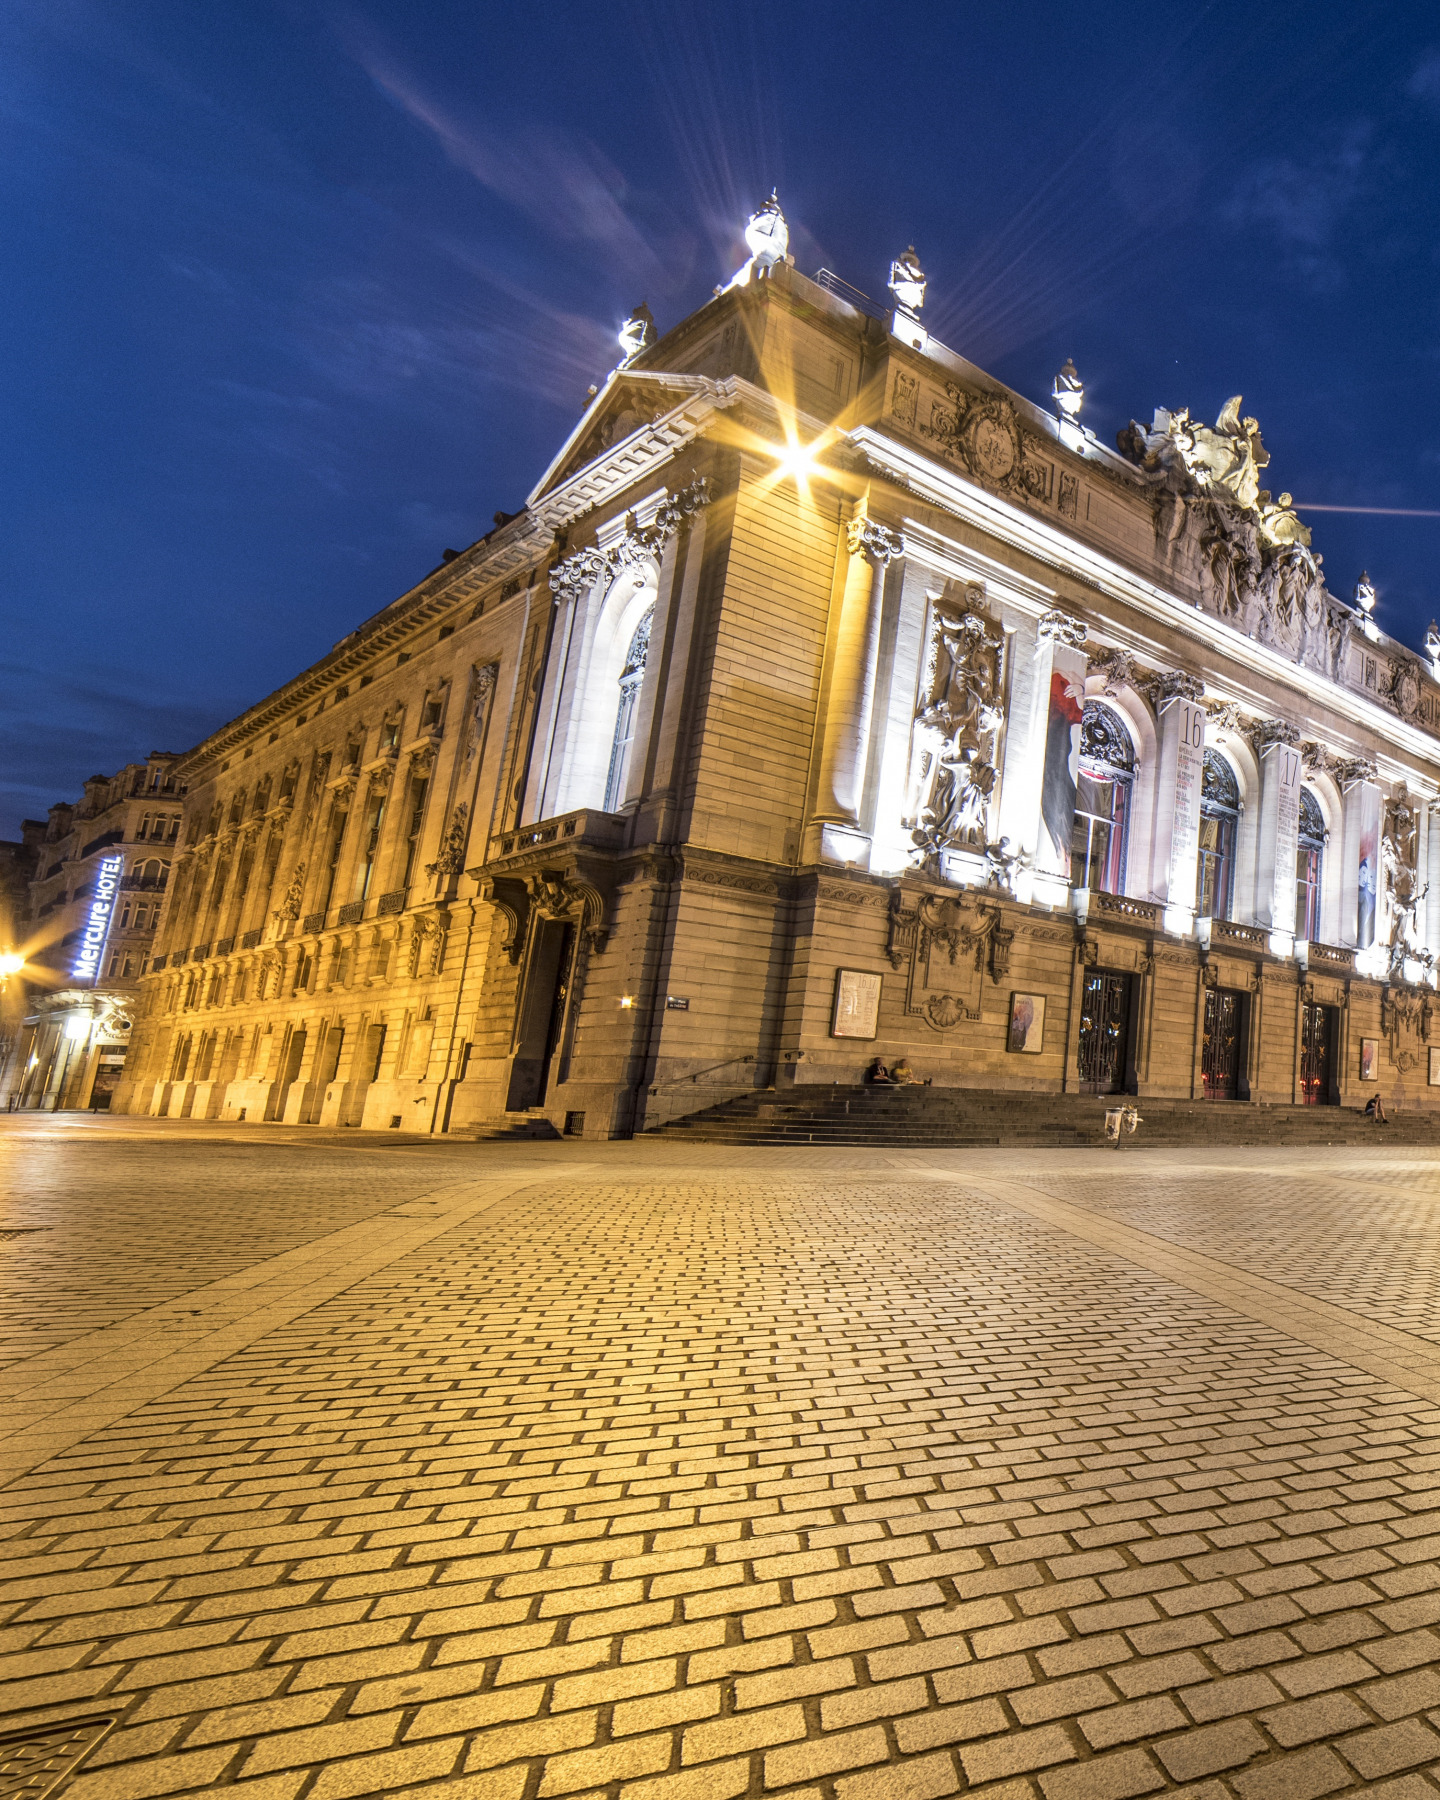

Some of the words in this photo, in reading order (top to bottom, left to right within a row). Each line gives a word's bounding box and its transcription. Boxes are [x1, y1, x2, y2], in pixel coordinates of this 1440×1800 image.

[1181, 706, 1202, 748] 16
[1283, 751, 1299, 788] 17
[72, 901, 110, 977] Mercure
[95, 856, 121, 900] HOTEL
